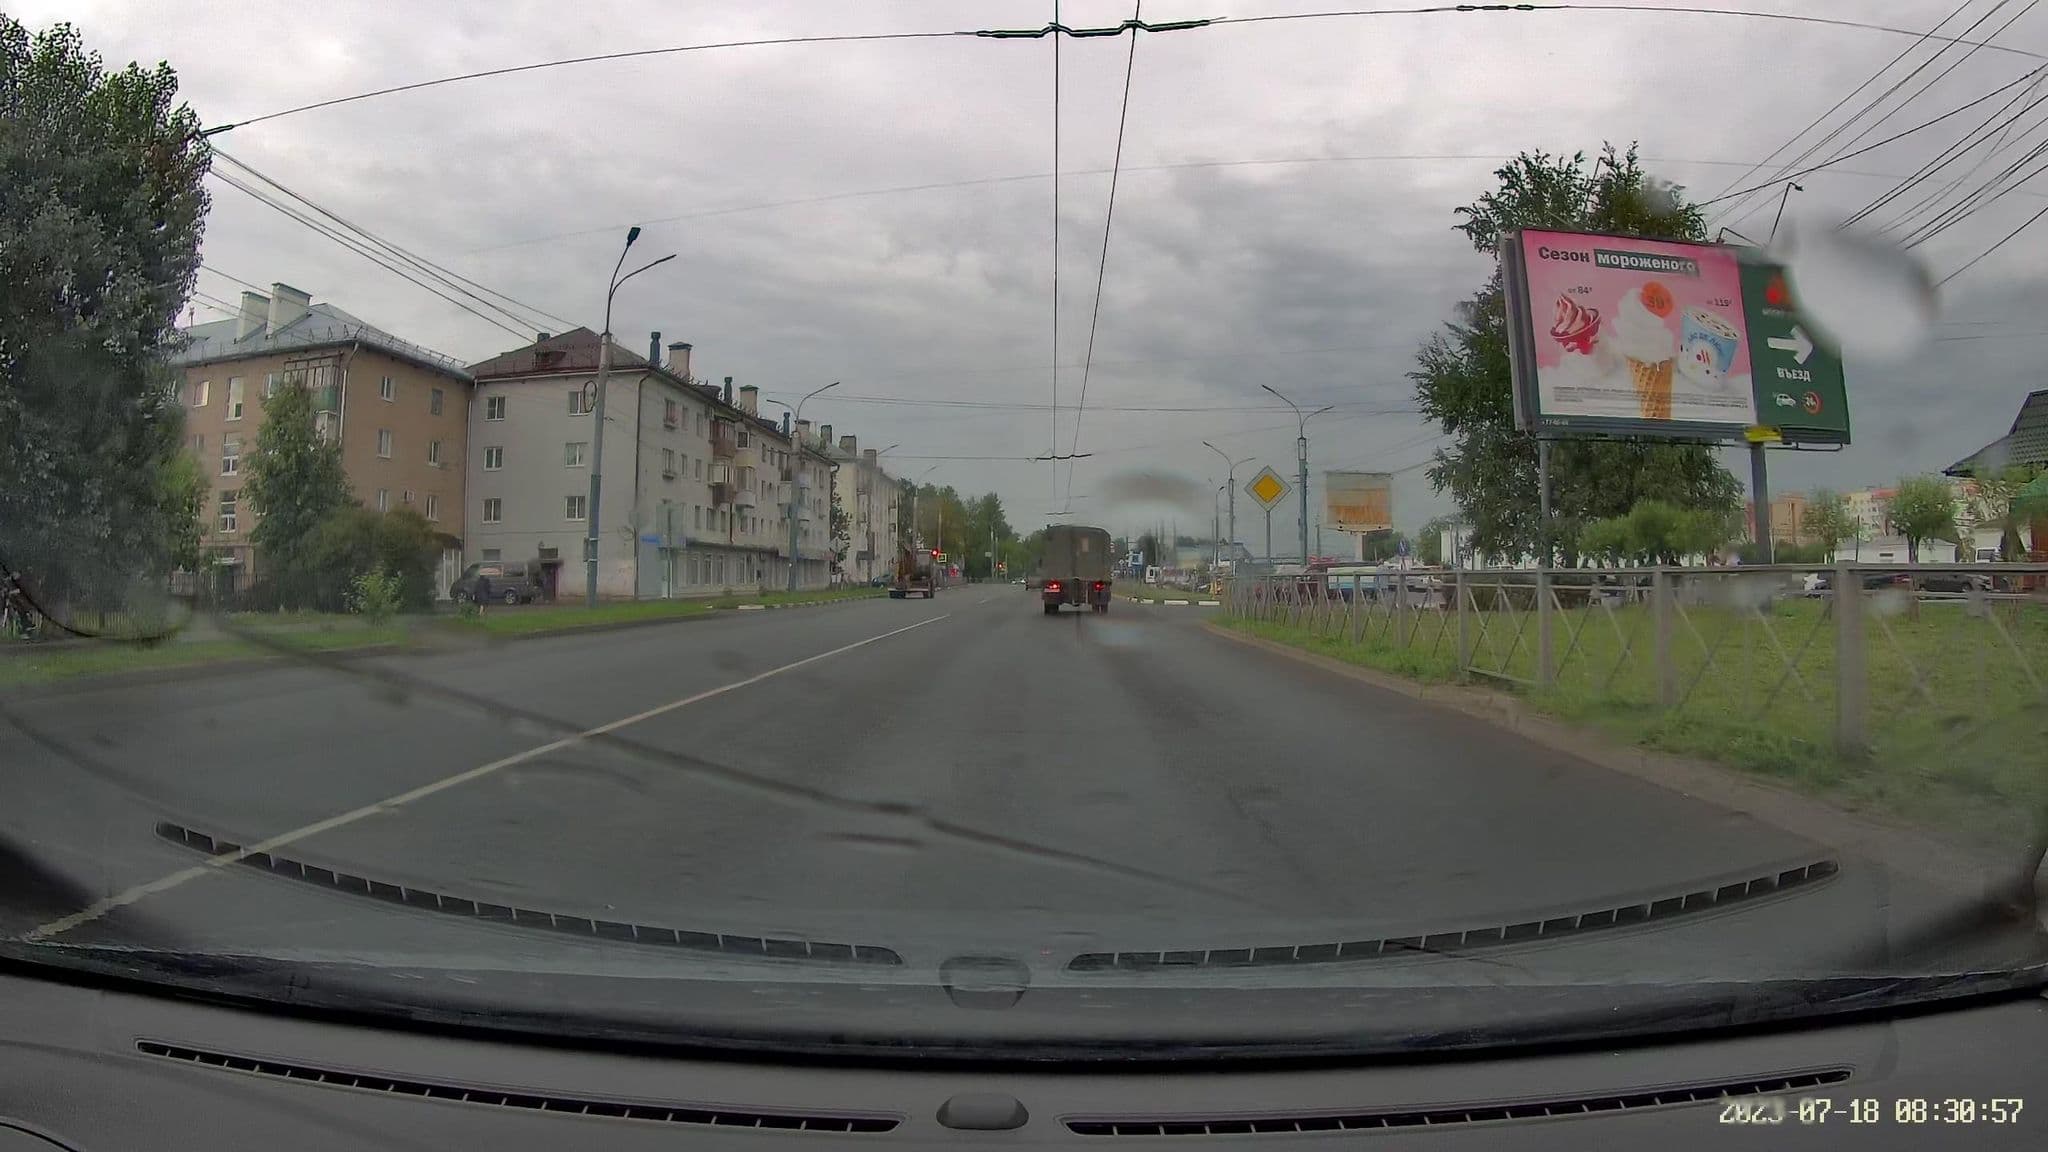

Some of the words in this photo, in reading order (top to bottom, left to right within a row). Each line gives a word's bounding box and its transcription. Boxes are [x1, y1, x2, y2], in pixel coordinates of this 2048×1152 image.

[1538, 246, 1590, 263] Сезон
[1597, 252, 1696, 272] мороженого
[1776, 367, 1812, 382] ВЪЕЗД
